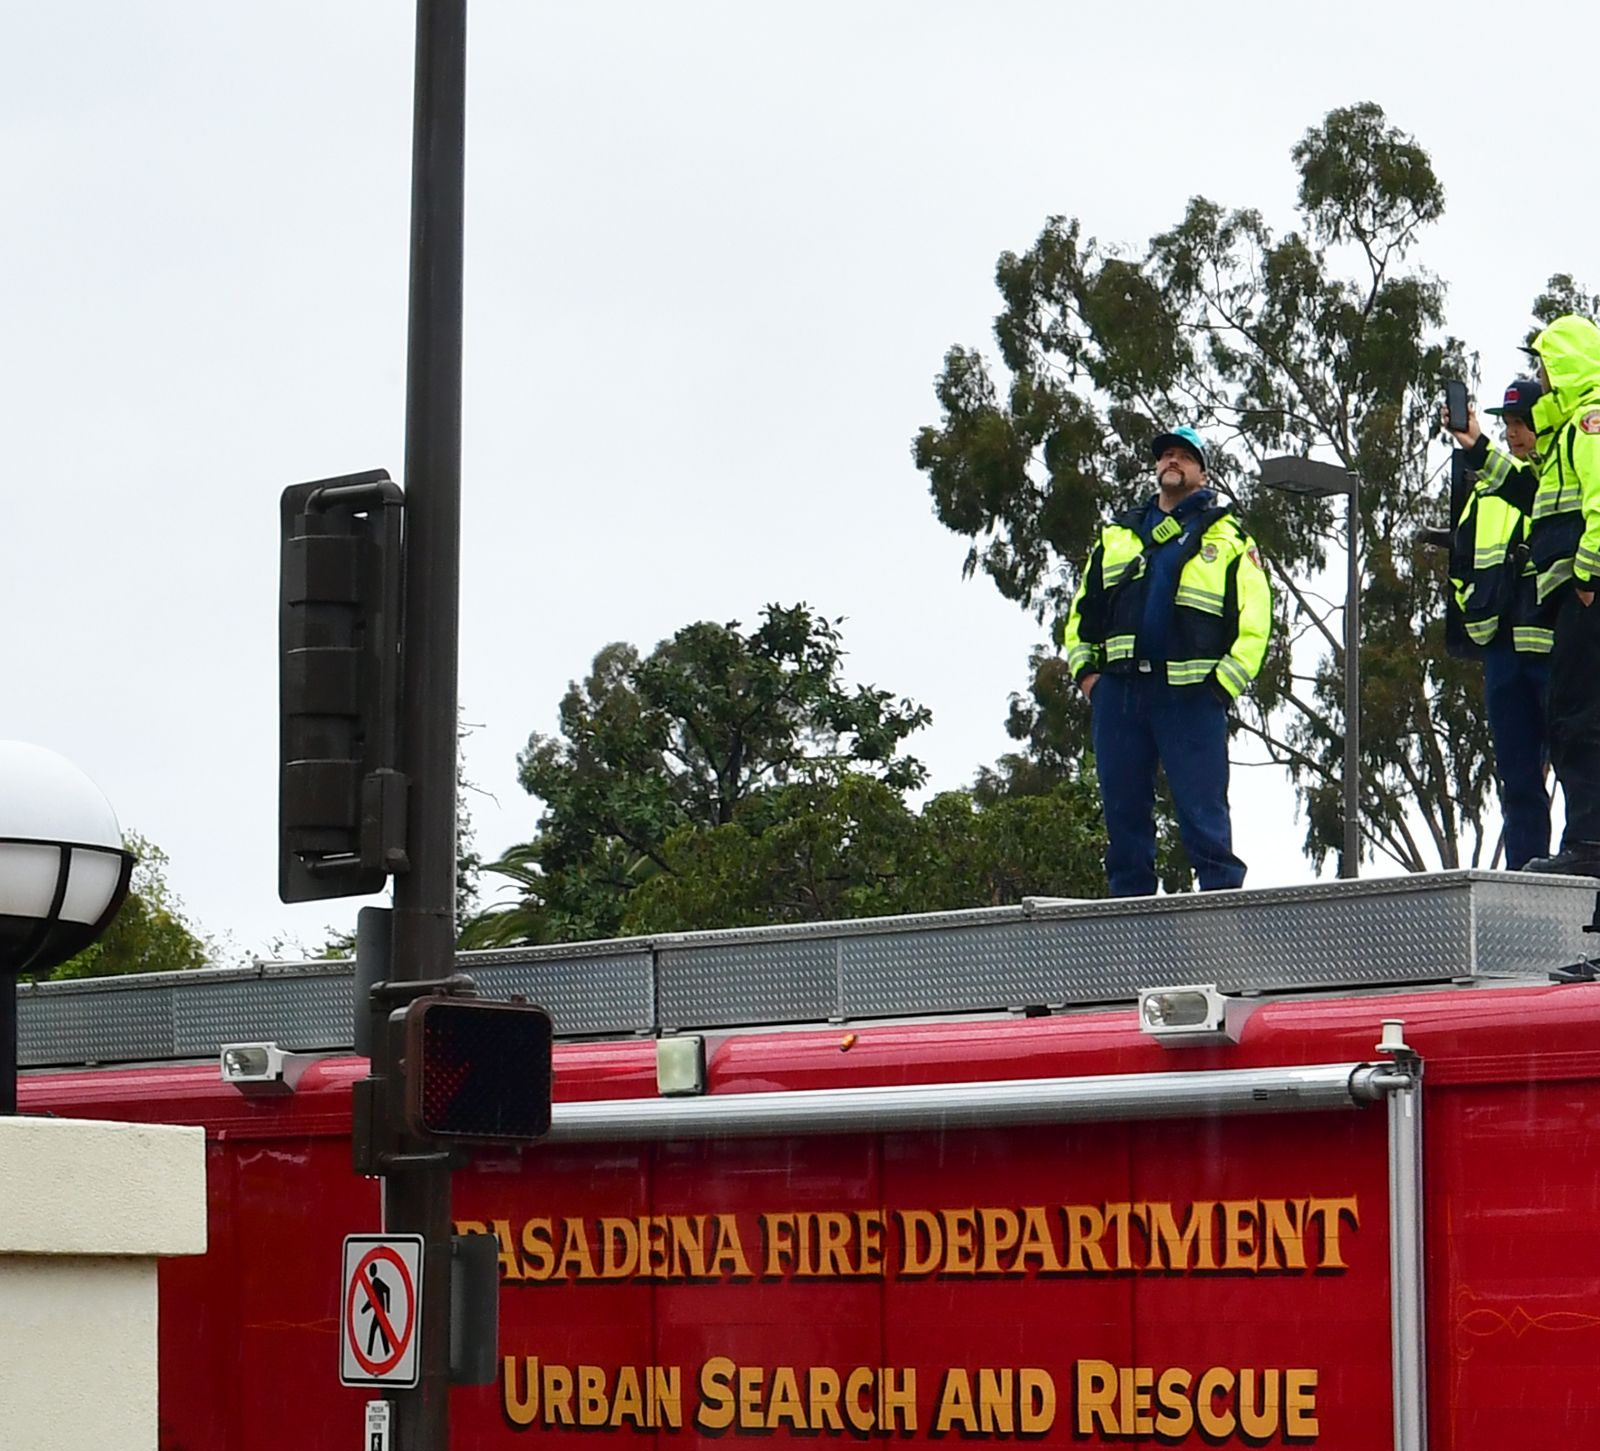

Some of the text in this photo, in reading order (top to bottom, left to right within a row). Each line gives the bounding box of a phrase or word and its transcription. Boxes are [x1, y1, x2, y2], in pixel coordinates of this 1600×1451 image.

[762, 1210, 888, 1279] FIRE
[896, 1195, 1361, 1277] DEPARTMENT
[503, 1355, 1320, 1439] URBAN SEARCH AND RESCUE
